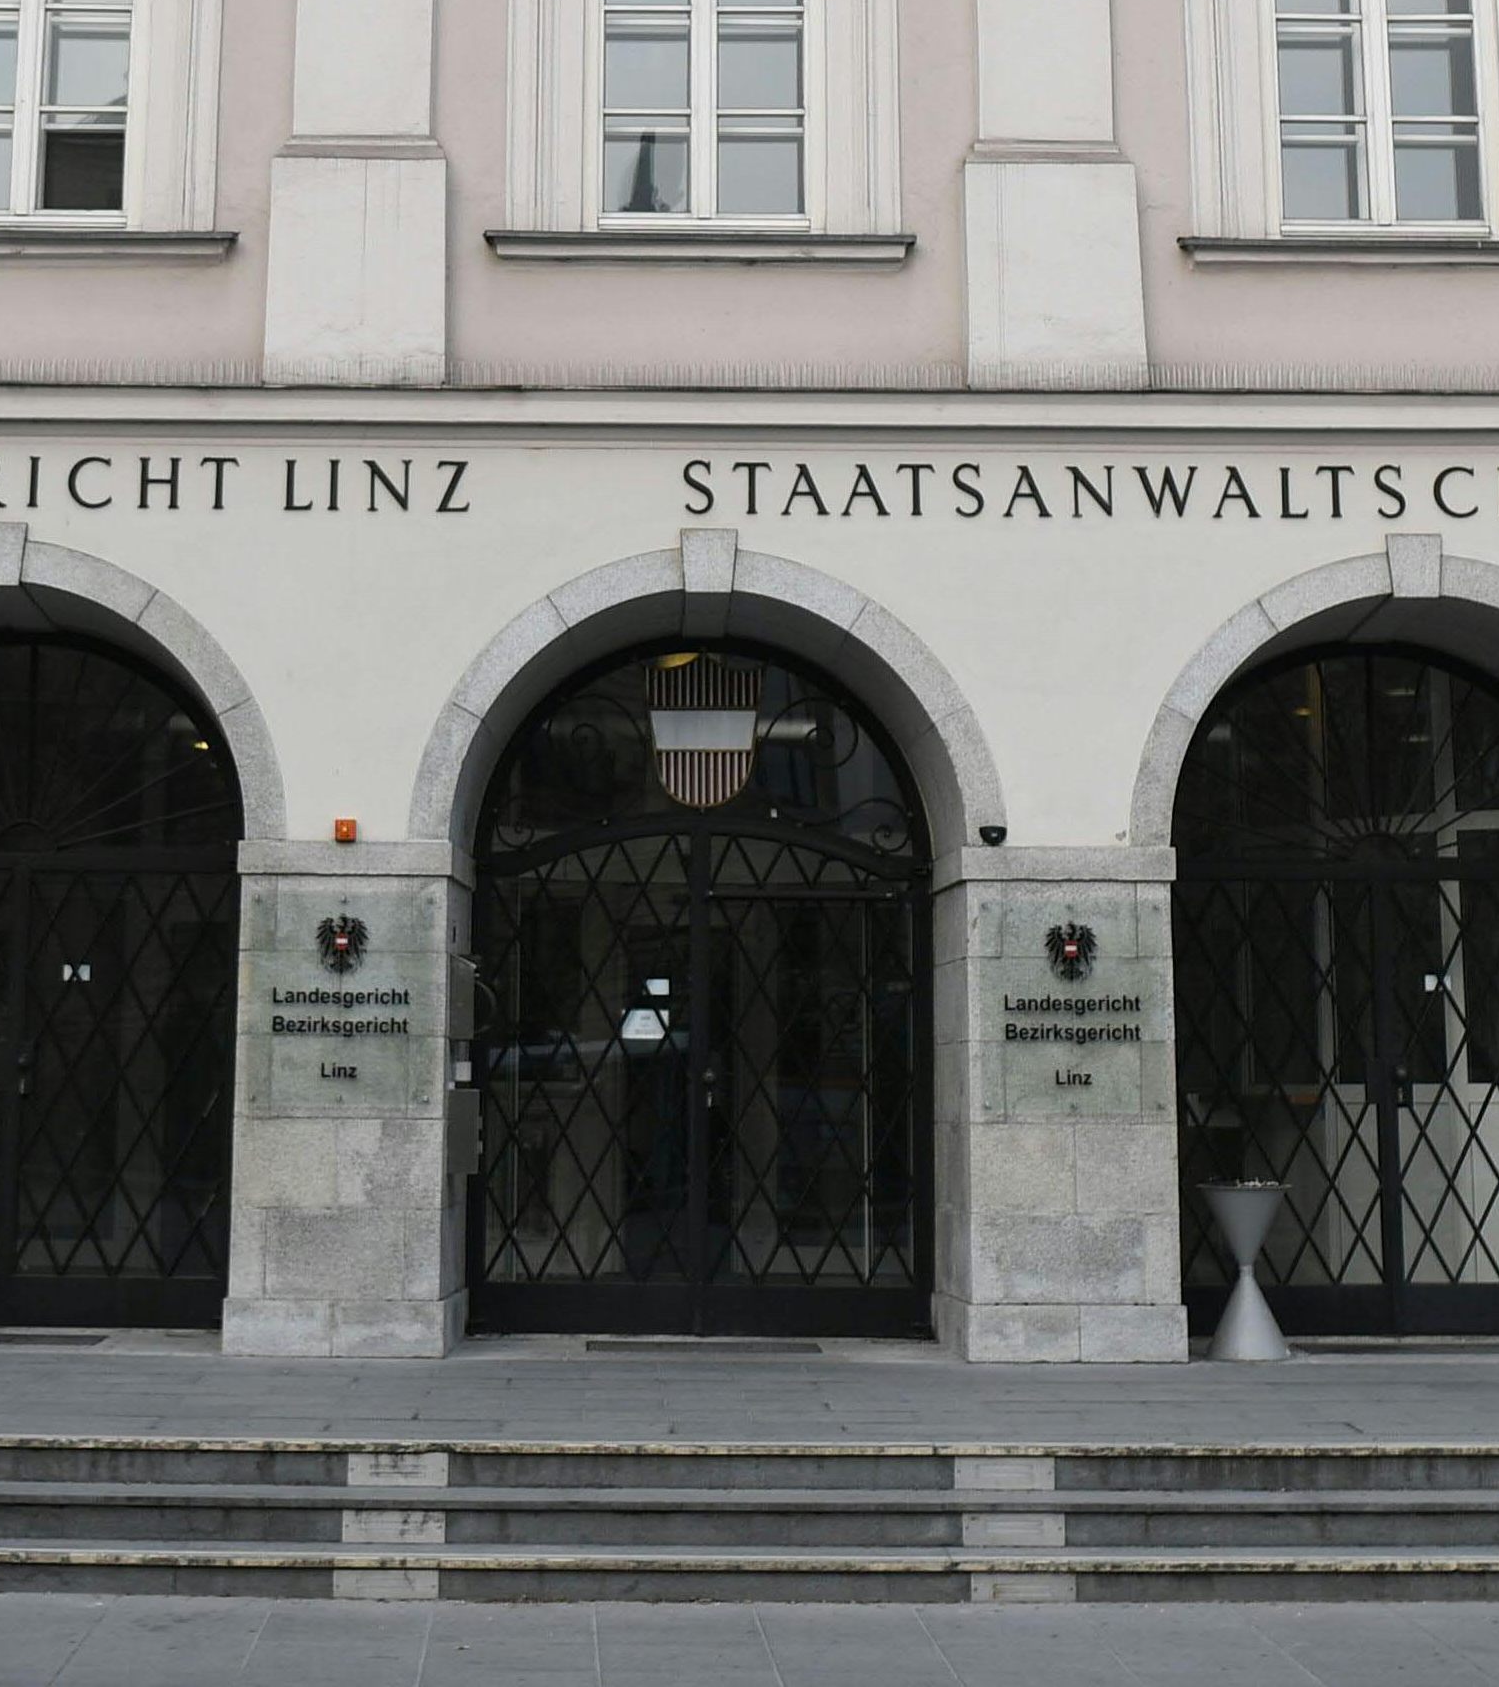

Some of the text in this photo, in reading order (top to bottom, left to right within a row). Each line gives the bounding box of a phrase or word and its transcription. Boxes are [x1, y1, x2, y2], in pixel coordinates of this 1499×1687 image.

[284, 458, 471, 513] LINZ
[273, 987, 411, 1008] Landesgericht
[1004, 994, 1141, 1015] Landesgericht
[272, 1015, 409, 1037] Bezirksgericht
[1005, 1023, 1141, 1044] Bezirksgericht
[321, 1063, 358, 1079] Linz
[1055, 1069, 1093, 1086] Linz
